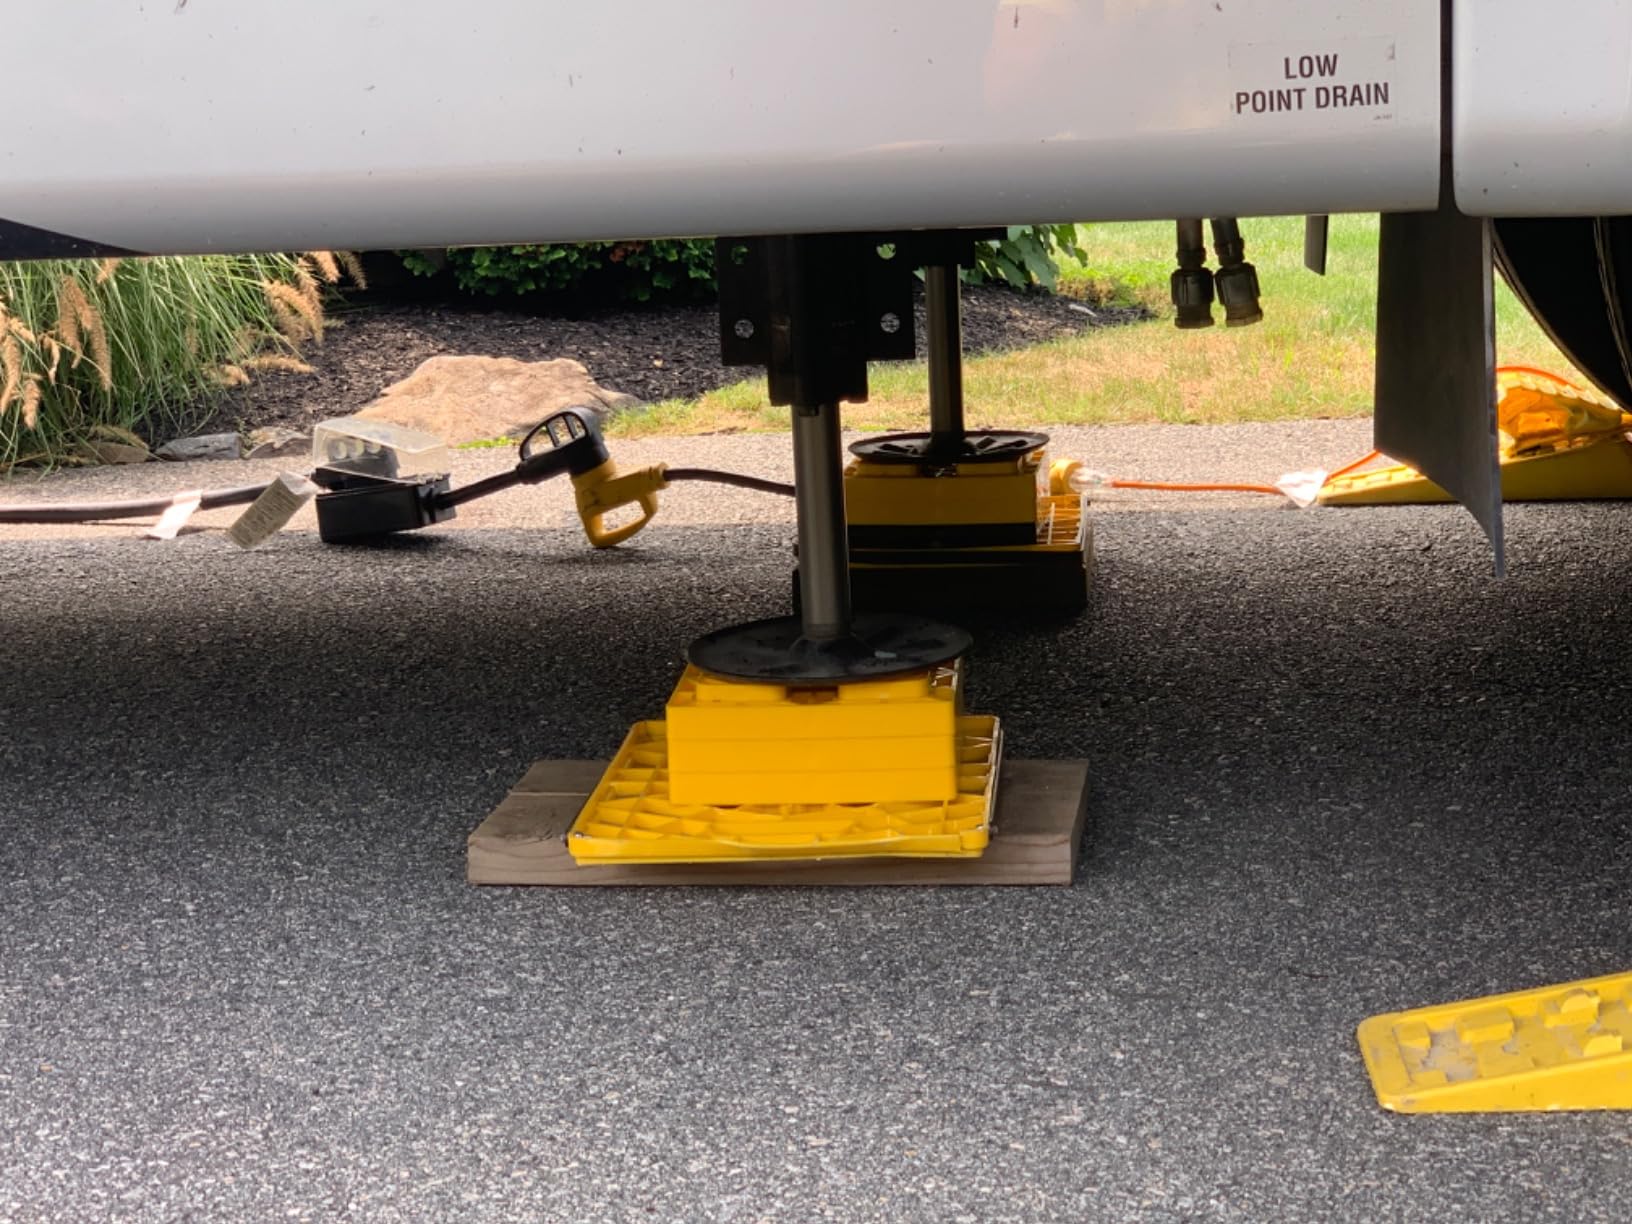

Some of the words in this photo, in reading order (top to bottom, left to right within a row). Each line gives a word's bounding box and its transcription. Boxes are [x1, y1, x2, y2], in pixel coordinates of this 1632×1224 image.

[1285, 54, 1338, 79] LOW
[1235, 88, 1306, 114] POINT
[1315, 82, 1388, 109] DRAIN
